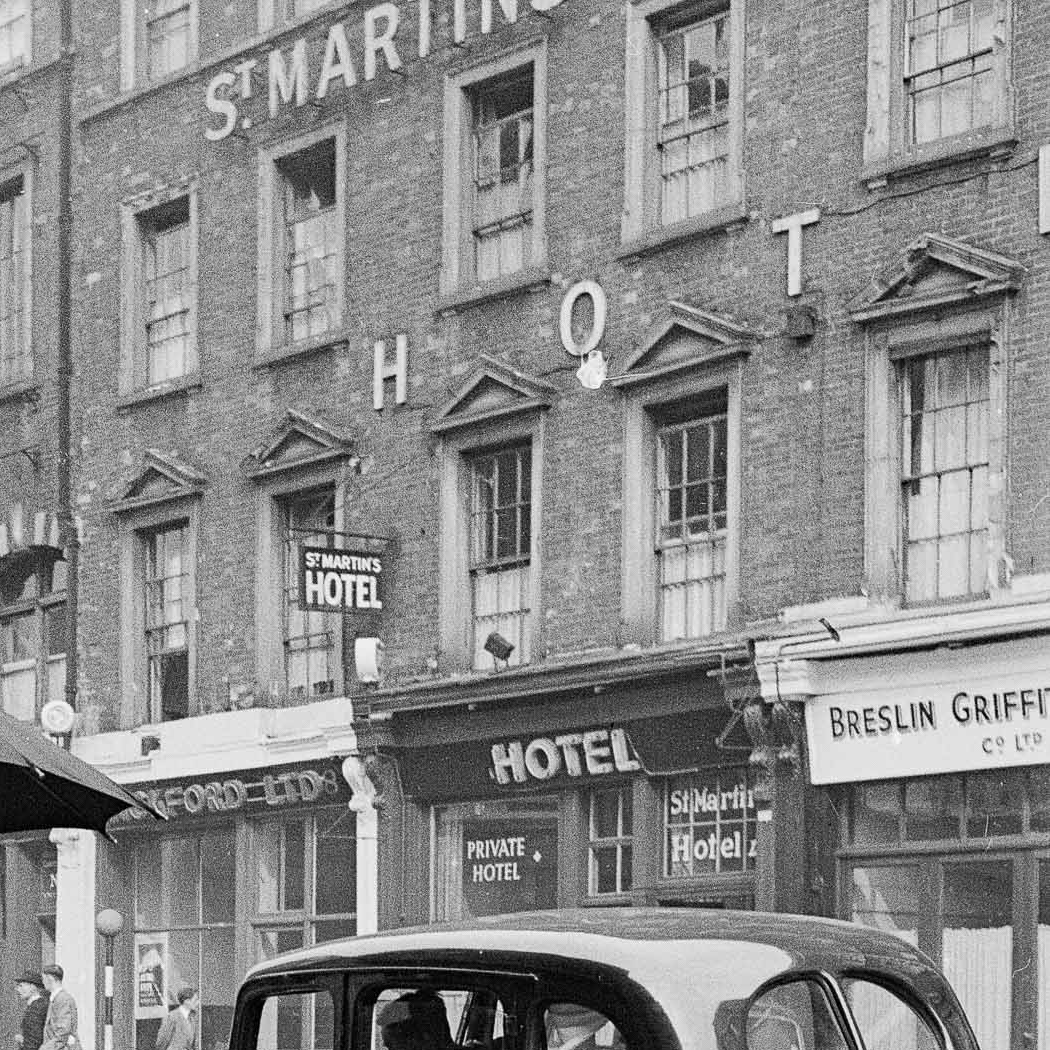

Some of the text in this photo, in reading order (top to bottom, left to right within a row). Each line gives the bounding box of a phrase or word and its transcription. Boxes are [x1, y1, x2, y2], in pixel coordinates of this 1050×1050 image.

[305, 570, 382, 609] HOTEL
[829, 701, 935, 738] BRESLIN
[491, 728, 641, 784] HOTEL
[467, 837, 526, 859] PRIVATE
[671, 831, 742, 862] Hotel
[472, 862, 521, 882] HOTEL
